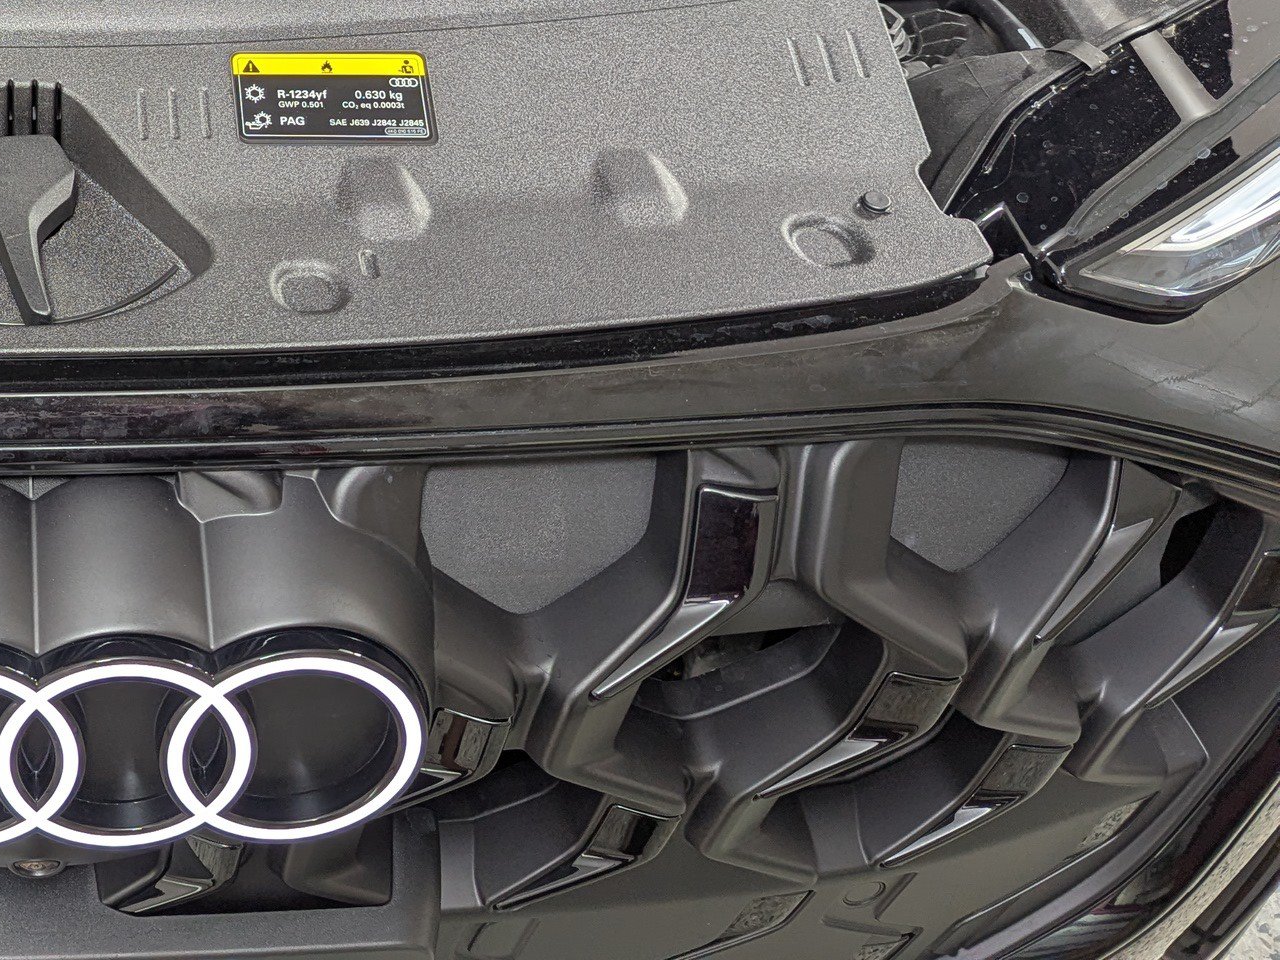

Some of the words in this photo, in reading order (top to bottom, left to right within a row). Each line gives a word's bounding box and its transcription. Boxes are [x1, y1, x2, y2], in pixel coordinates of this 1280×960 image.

[277, 89, 327, 102] R-1234yf
[354, 90, 386, 100] 0.630
[389, 90, 403, 102] kg
[280, 116, 306, 126] PAG
[350, 118, 370, 126] J639
[399, 119, 424, 127] J2845
